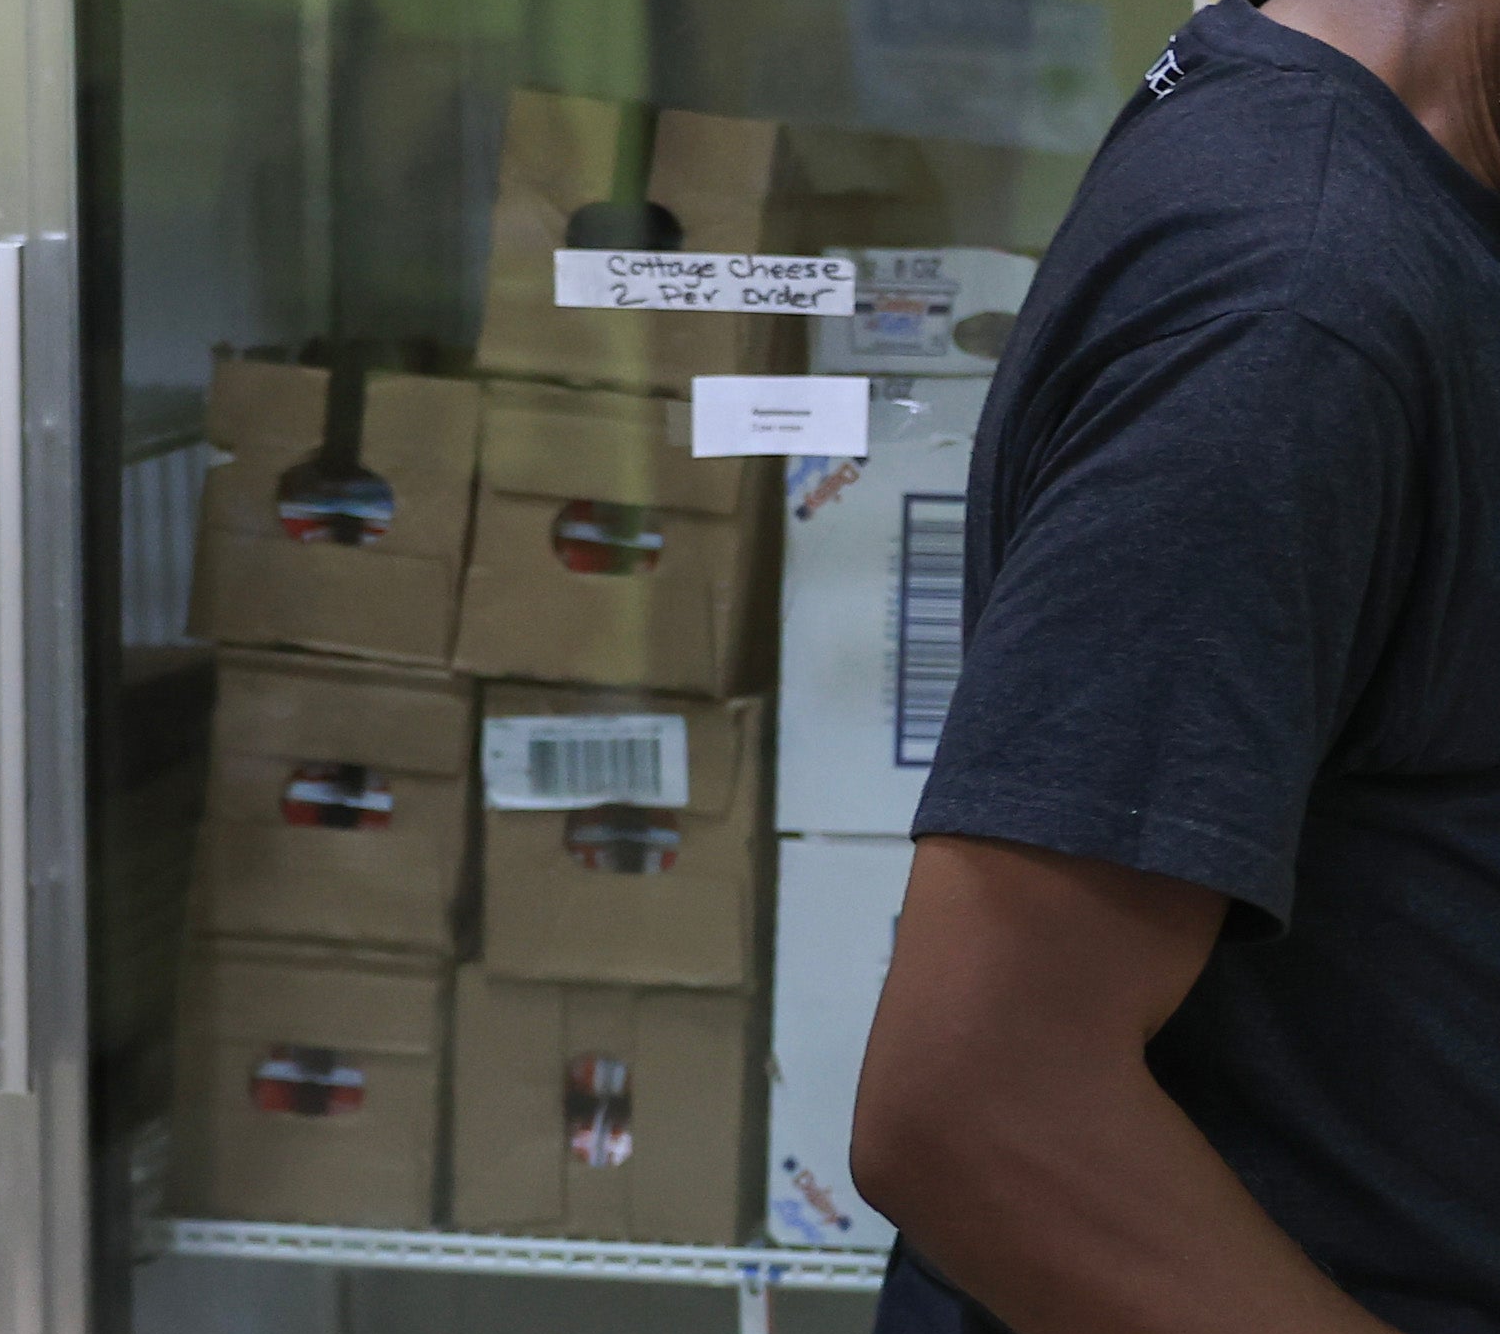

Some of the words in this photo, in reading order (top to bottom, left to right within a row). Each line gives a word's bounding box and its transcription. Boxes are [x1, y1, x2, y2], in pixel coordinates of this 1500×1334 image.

[606, 255, 717, 288] Cottage
[727, 254, 852, 281] Cheese
[610, 283, 649, 307] 2
[658, 284, 720, 305] Per
